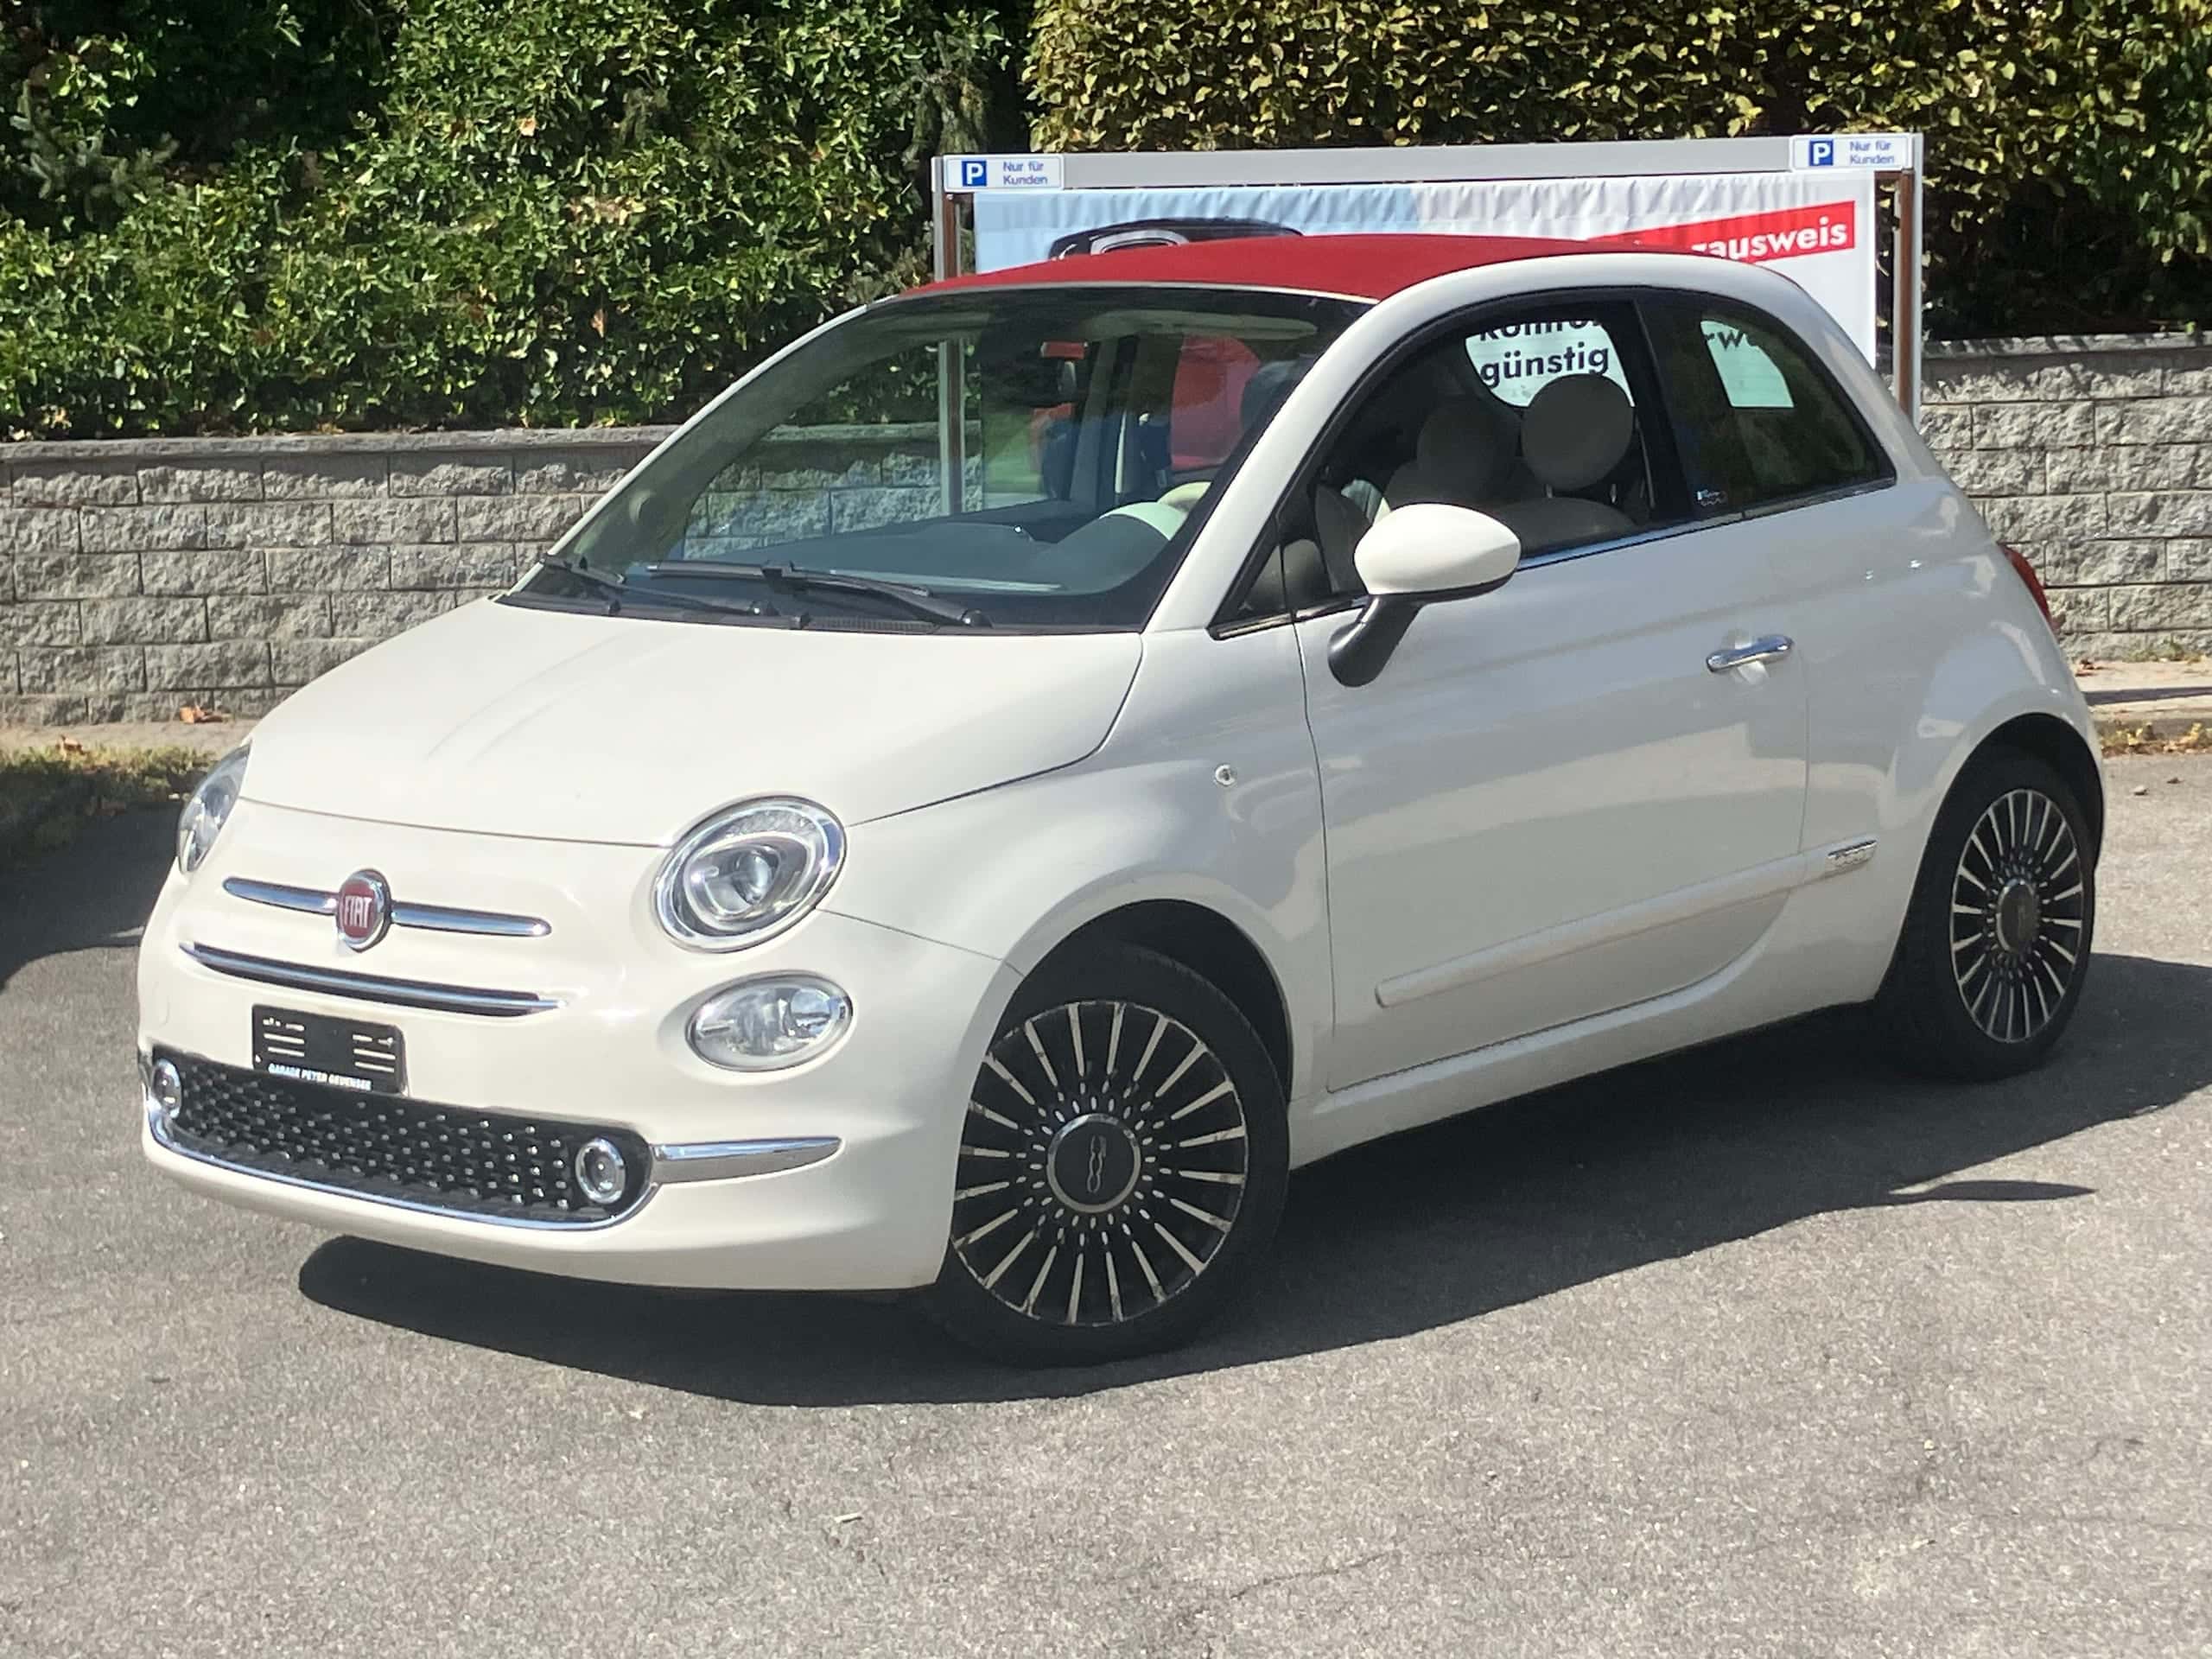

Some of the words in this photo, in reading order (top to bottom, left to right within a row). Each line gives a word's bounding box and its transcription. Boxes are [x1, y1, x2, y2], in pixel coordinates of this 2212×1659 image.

[1813, 143, 1831, 164] P
[1850, 141, 1870, 151] Nur
[1875, 140, 1891, 151] für
[1850, 155, 1895, 165] Kunden
[966, 162, 983, 185] P
[1003, 161, 1023, 172] Nur
[1028, 160, 1044, 172] für
[1003, 175, 1048, 185] Kunden
[1480, 341, 1609, 389] günstig
[344, 895, 372, 929] FIAT
